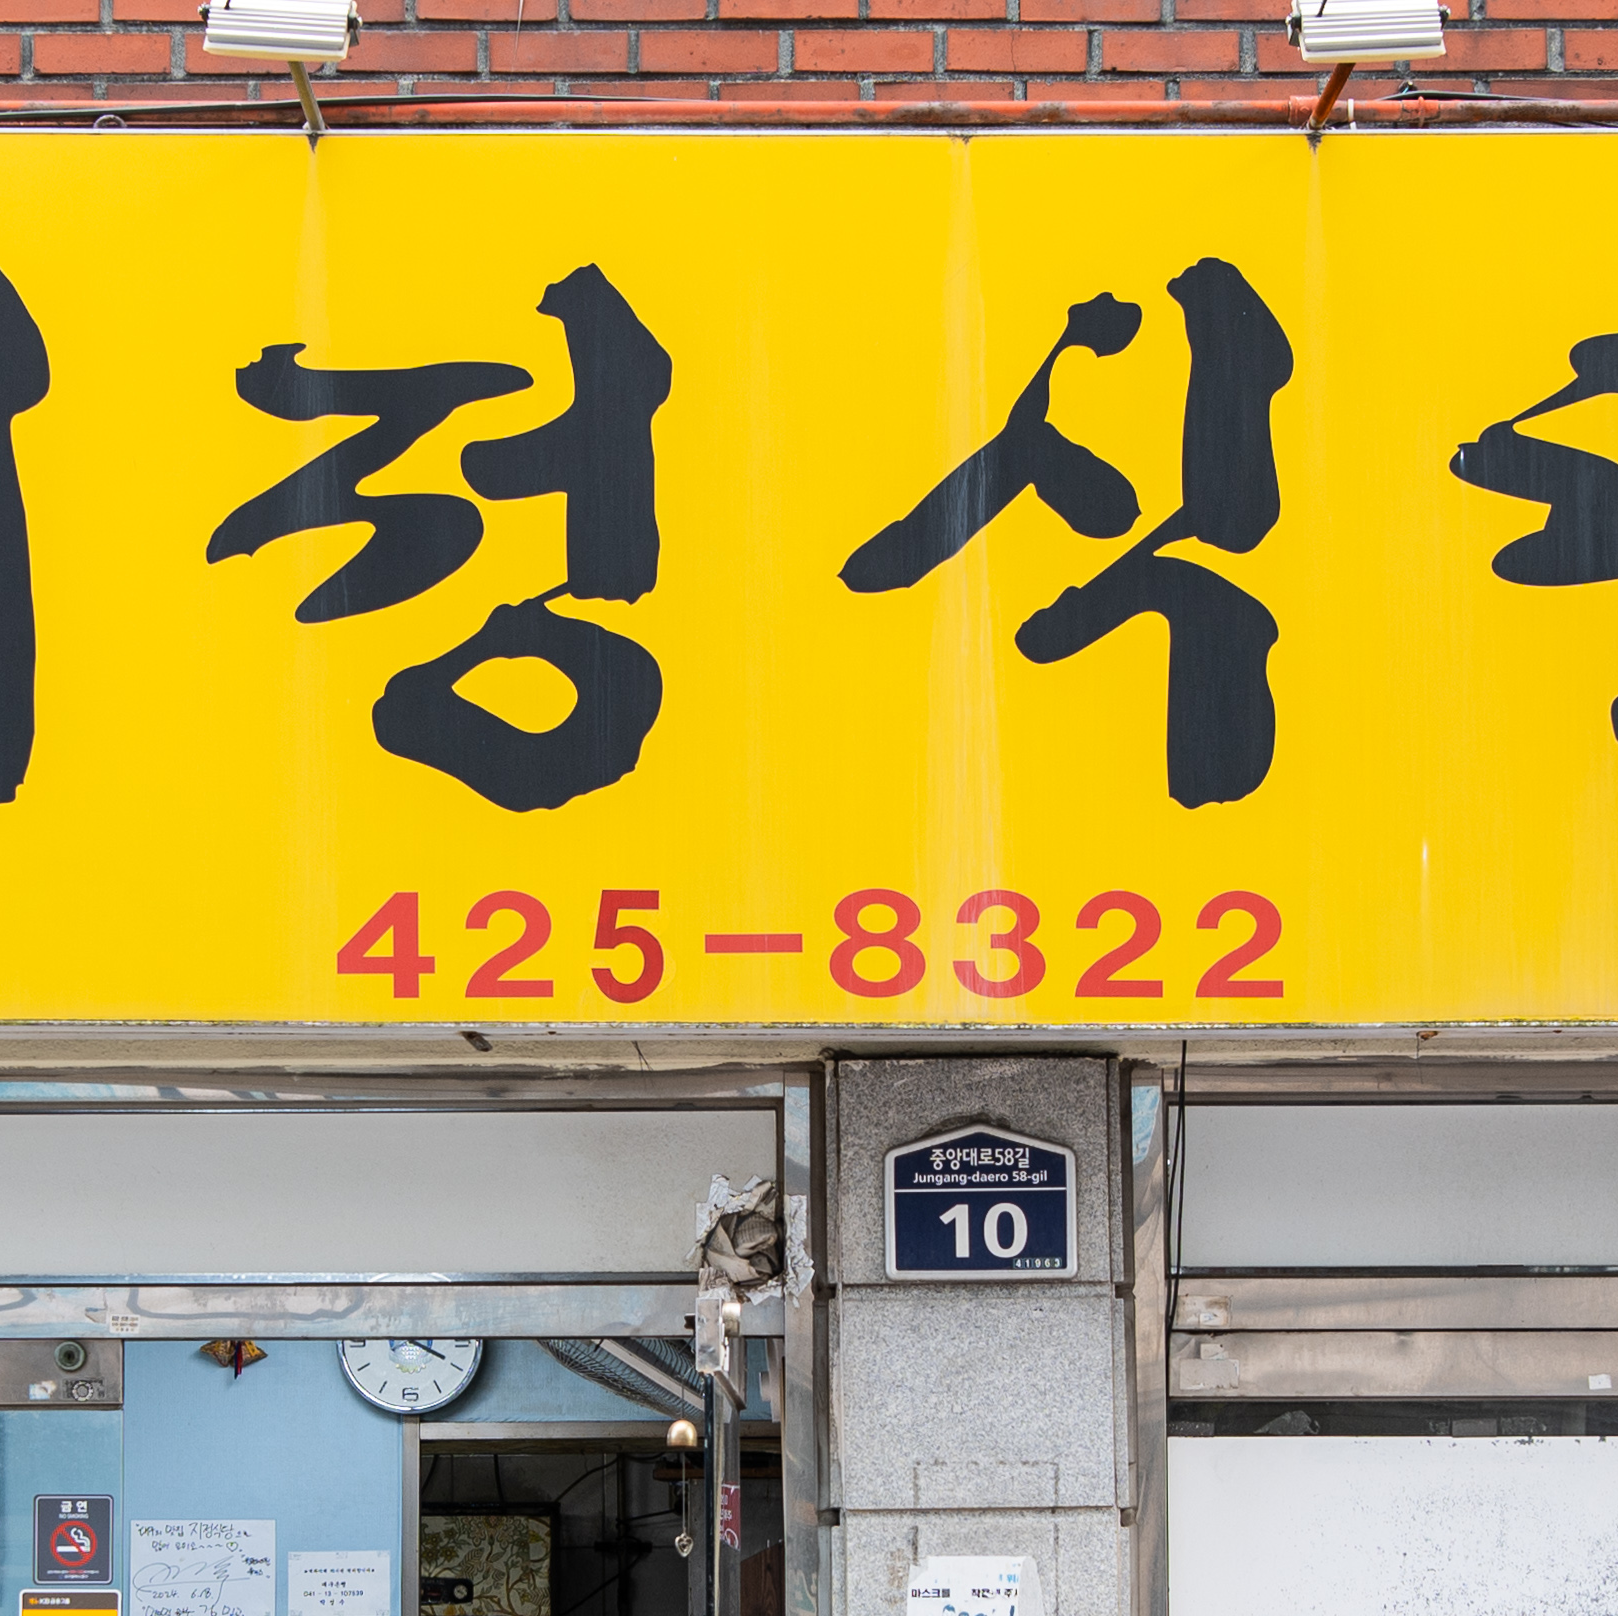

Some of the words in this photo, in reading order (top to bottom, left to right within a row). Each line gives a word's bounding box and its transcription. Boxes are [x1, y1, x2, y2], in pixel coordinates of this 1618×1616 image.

[338, 889, 1283, 1002] 425-8322
[929, 1147, 1030, 1171] 중앙대로58길
[913, 1171, 1008, 1186] Jungang-daero
[1012, 1170, 1047, 1184] 58-gil
[939, 1202, 1028, 1259] 10
[1014, 1258, 1062, 1269] 41963
[61, 1501, 88, 1513] 금연
[911, 1588, 951, 1598] 마스크를
